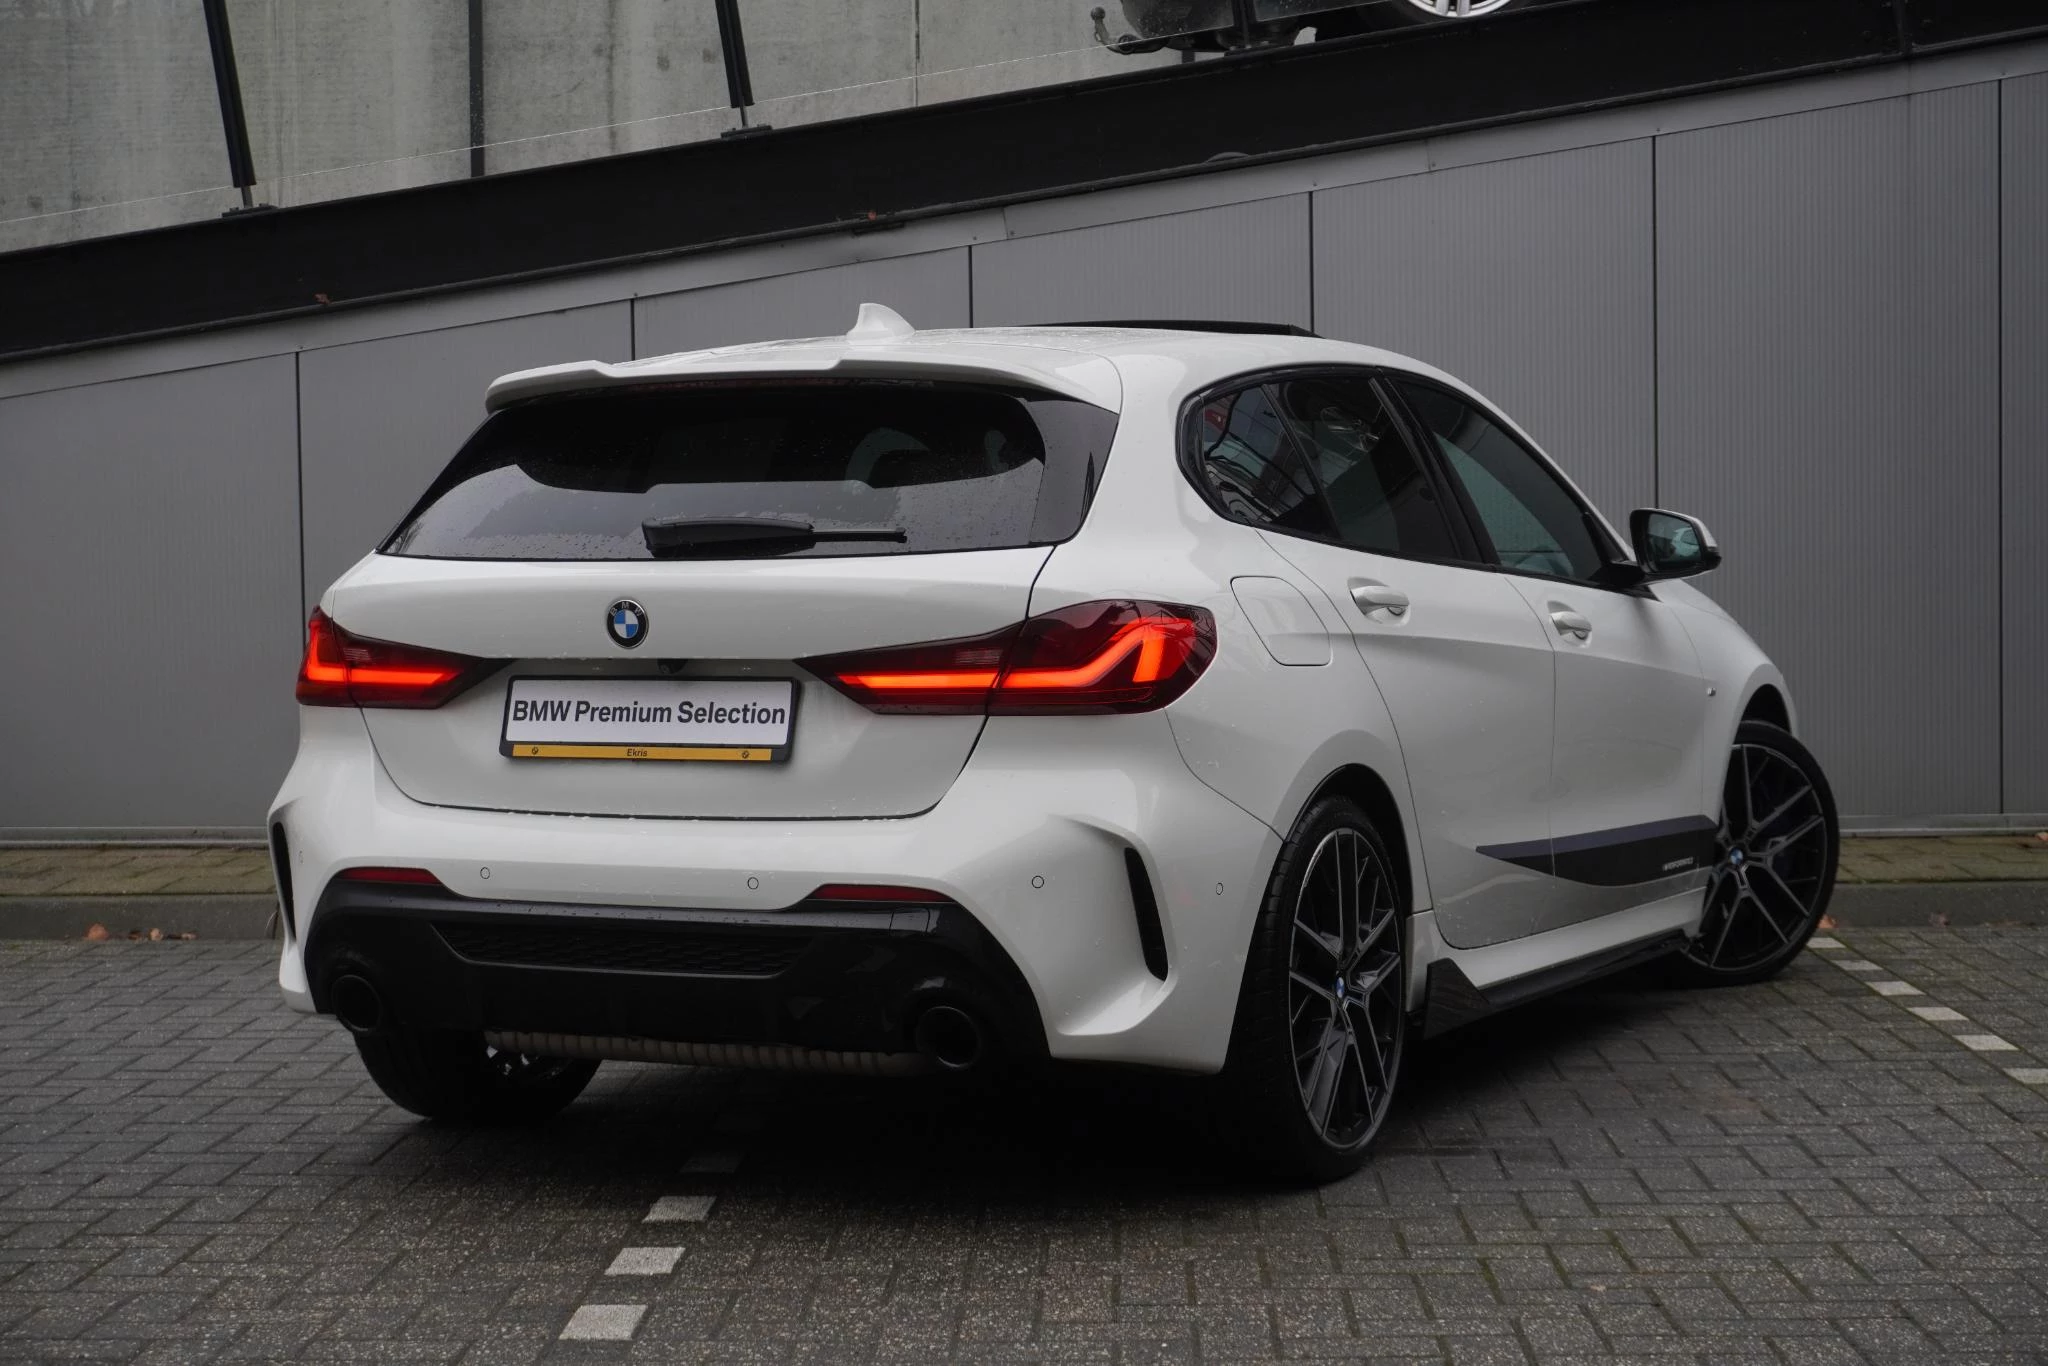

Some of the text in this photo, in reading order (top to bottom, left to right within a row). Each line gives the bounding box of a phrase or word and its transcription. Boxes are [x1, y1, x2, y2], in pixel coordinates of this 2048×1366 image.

[609, 601, 643, 617] BMW
[513, 700, 786, 724] BMW Premium Selection
[626, 748, 648, 757] Ekris
